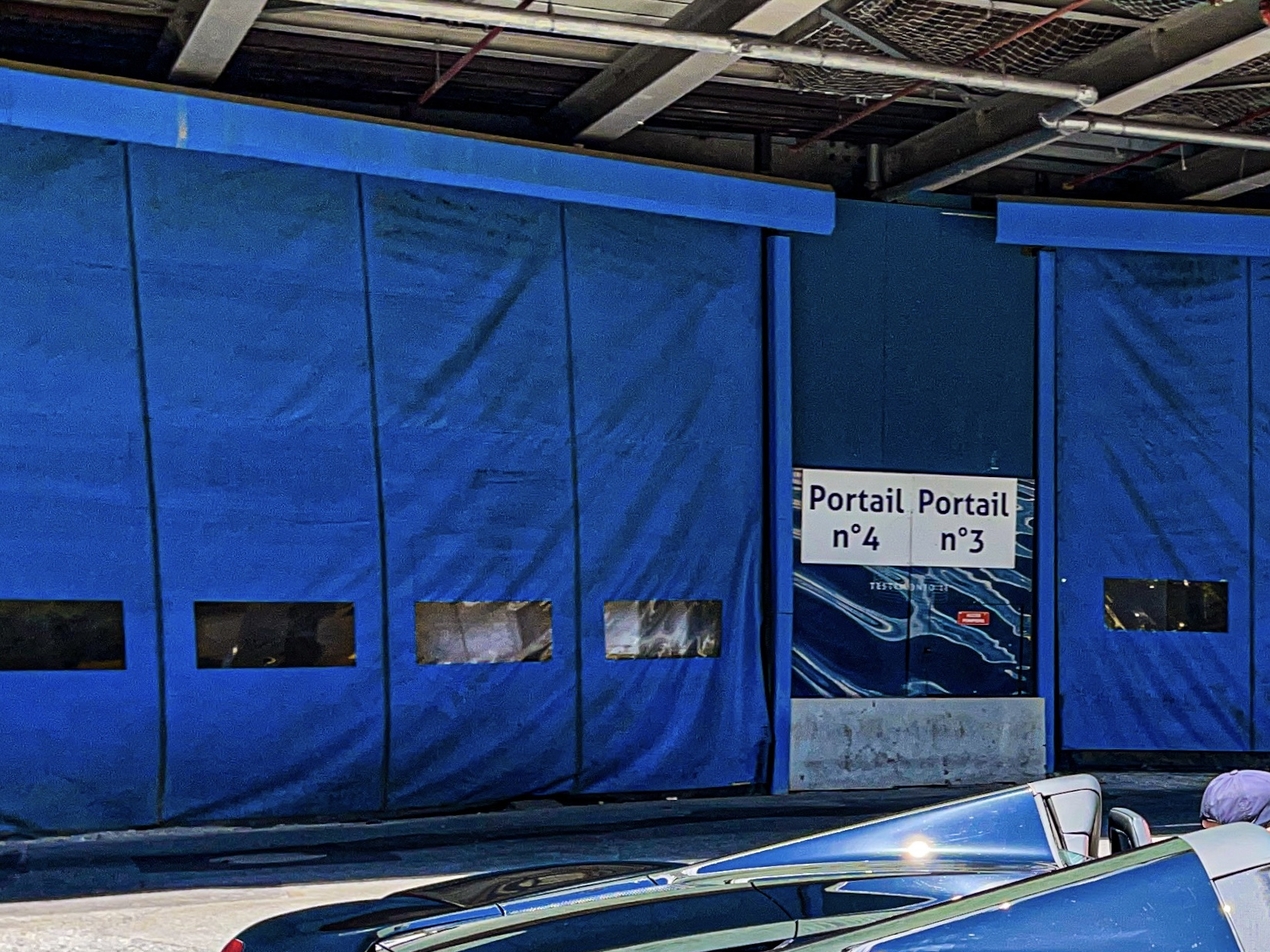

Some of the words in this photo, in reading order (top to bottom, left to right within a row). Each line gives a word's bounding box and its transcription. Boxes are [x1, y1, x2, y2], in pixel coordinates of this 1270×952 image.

[809, 485, 904, 513] Portail
[918, 489, 1010, 517] Portail
[832, 523, 880, 551] n°4
[940, 527, 985, 554] n°3
